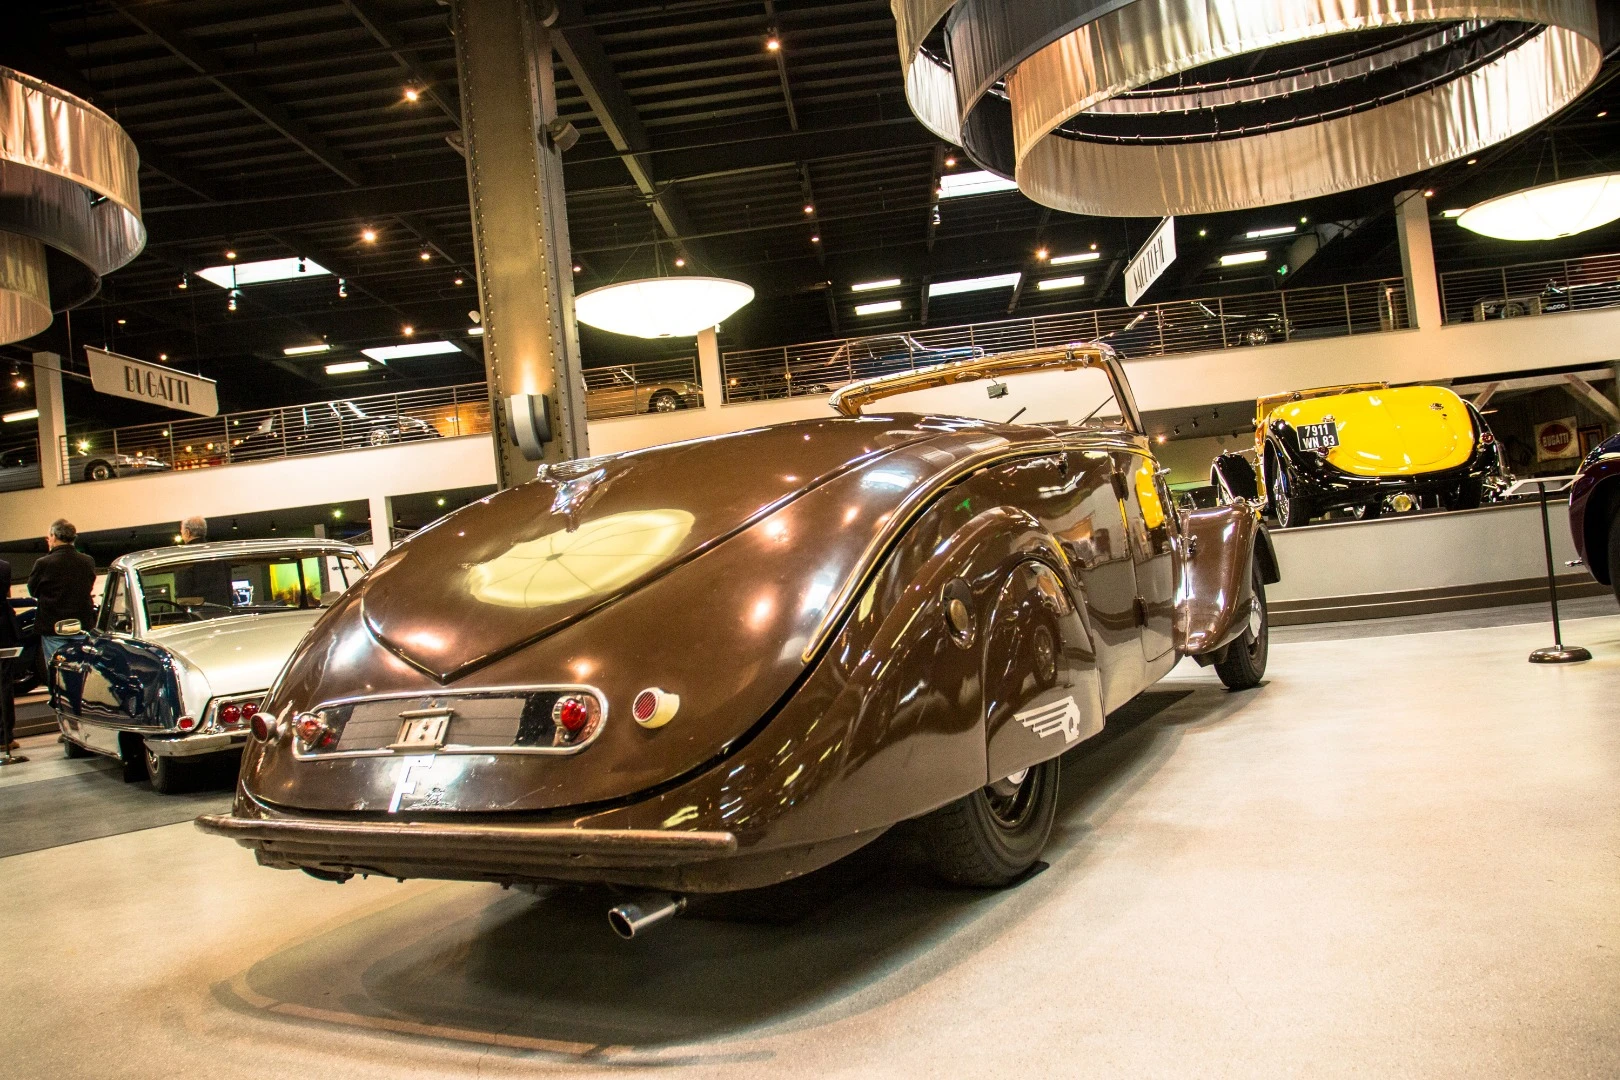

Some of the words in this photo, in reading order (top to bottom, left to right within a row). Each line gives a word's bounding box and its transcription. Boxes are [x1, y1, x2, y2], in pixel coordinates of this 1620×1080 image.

[124, 365, 190, 405] BUGATTI
[1305, 423, 1329, 437] 7911
[1302, 436, 1320, 449] WN
[1322, 435, 1336, 447] 83
[1542, 432, 1569, 447] BUGATTI
[388, 754, 436, 813] F
